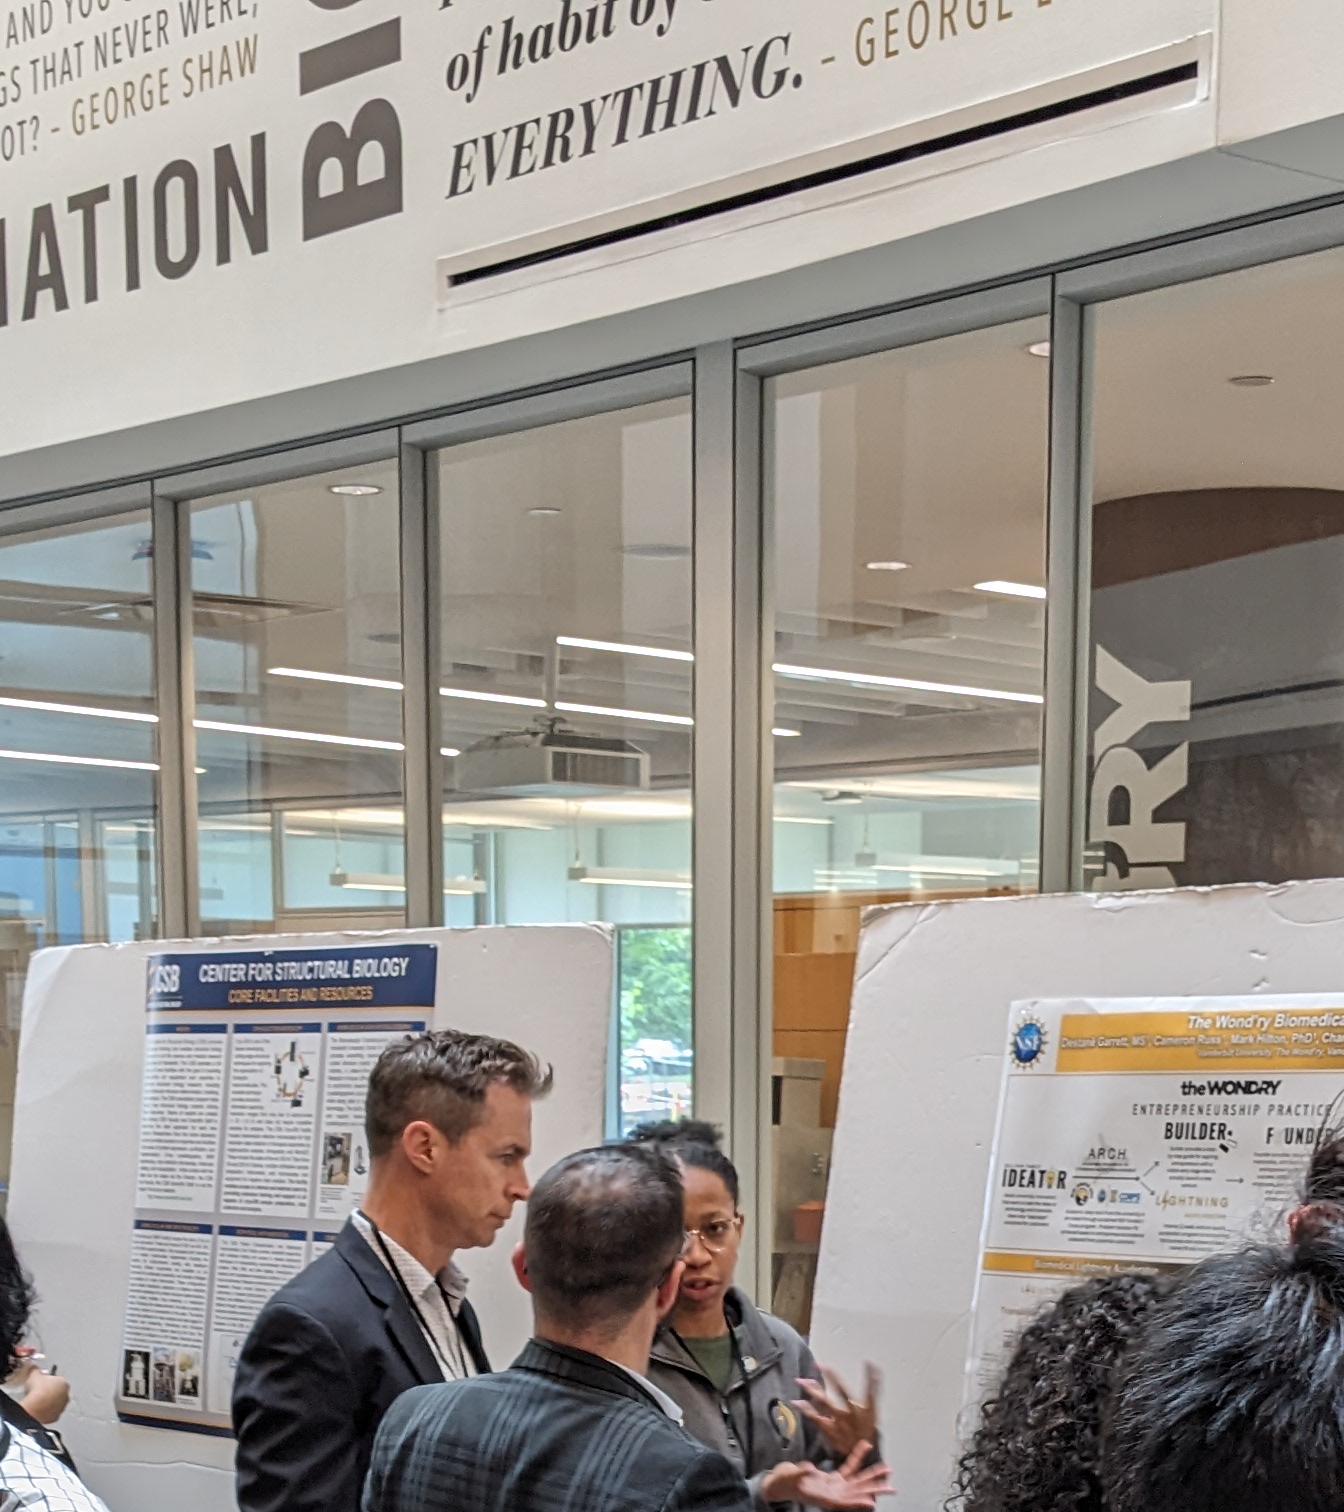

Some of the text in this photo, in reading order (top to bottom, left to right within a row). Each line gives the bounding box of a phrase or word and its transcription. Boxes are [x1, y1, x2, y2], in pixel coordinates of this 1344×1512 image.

[5, 0, 54, 49] AND
[29, 41, 85, 97] THAT
[94, 9, 170, 74] NEVER
[446, 25, 492, 103] of
[497, 0, 617, 75] habit
[71, 67, 171, 137] GEORGE
[182, 33, 260, 97] SHAW
[299, 0, 404, 241] BI
[444, 32, 804, 200] EVERYTHING.
[1087, 642, 1192, 890] RY
[199, 957, 410, 983] CENTER FOR STRUCTURAL BIOLOGY
[228, 988, 253, 1004] CORE
[320, 986, 374, 1001] RESOURCES
[1188, 1015, 1212, 1029] The
[1131, 1103, 1261, 1117] ENTREPRENEURSHIP
[1164, 1122, 1227, 1141] BUILDER
[1088, 1147, 1127, 1160] ARCH
